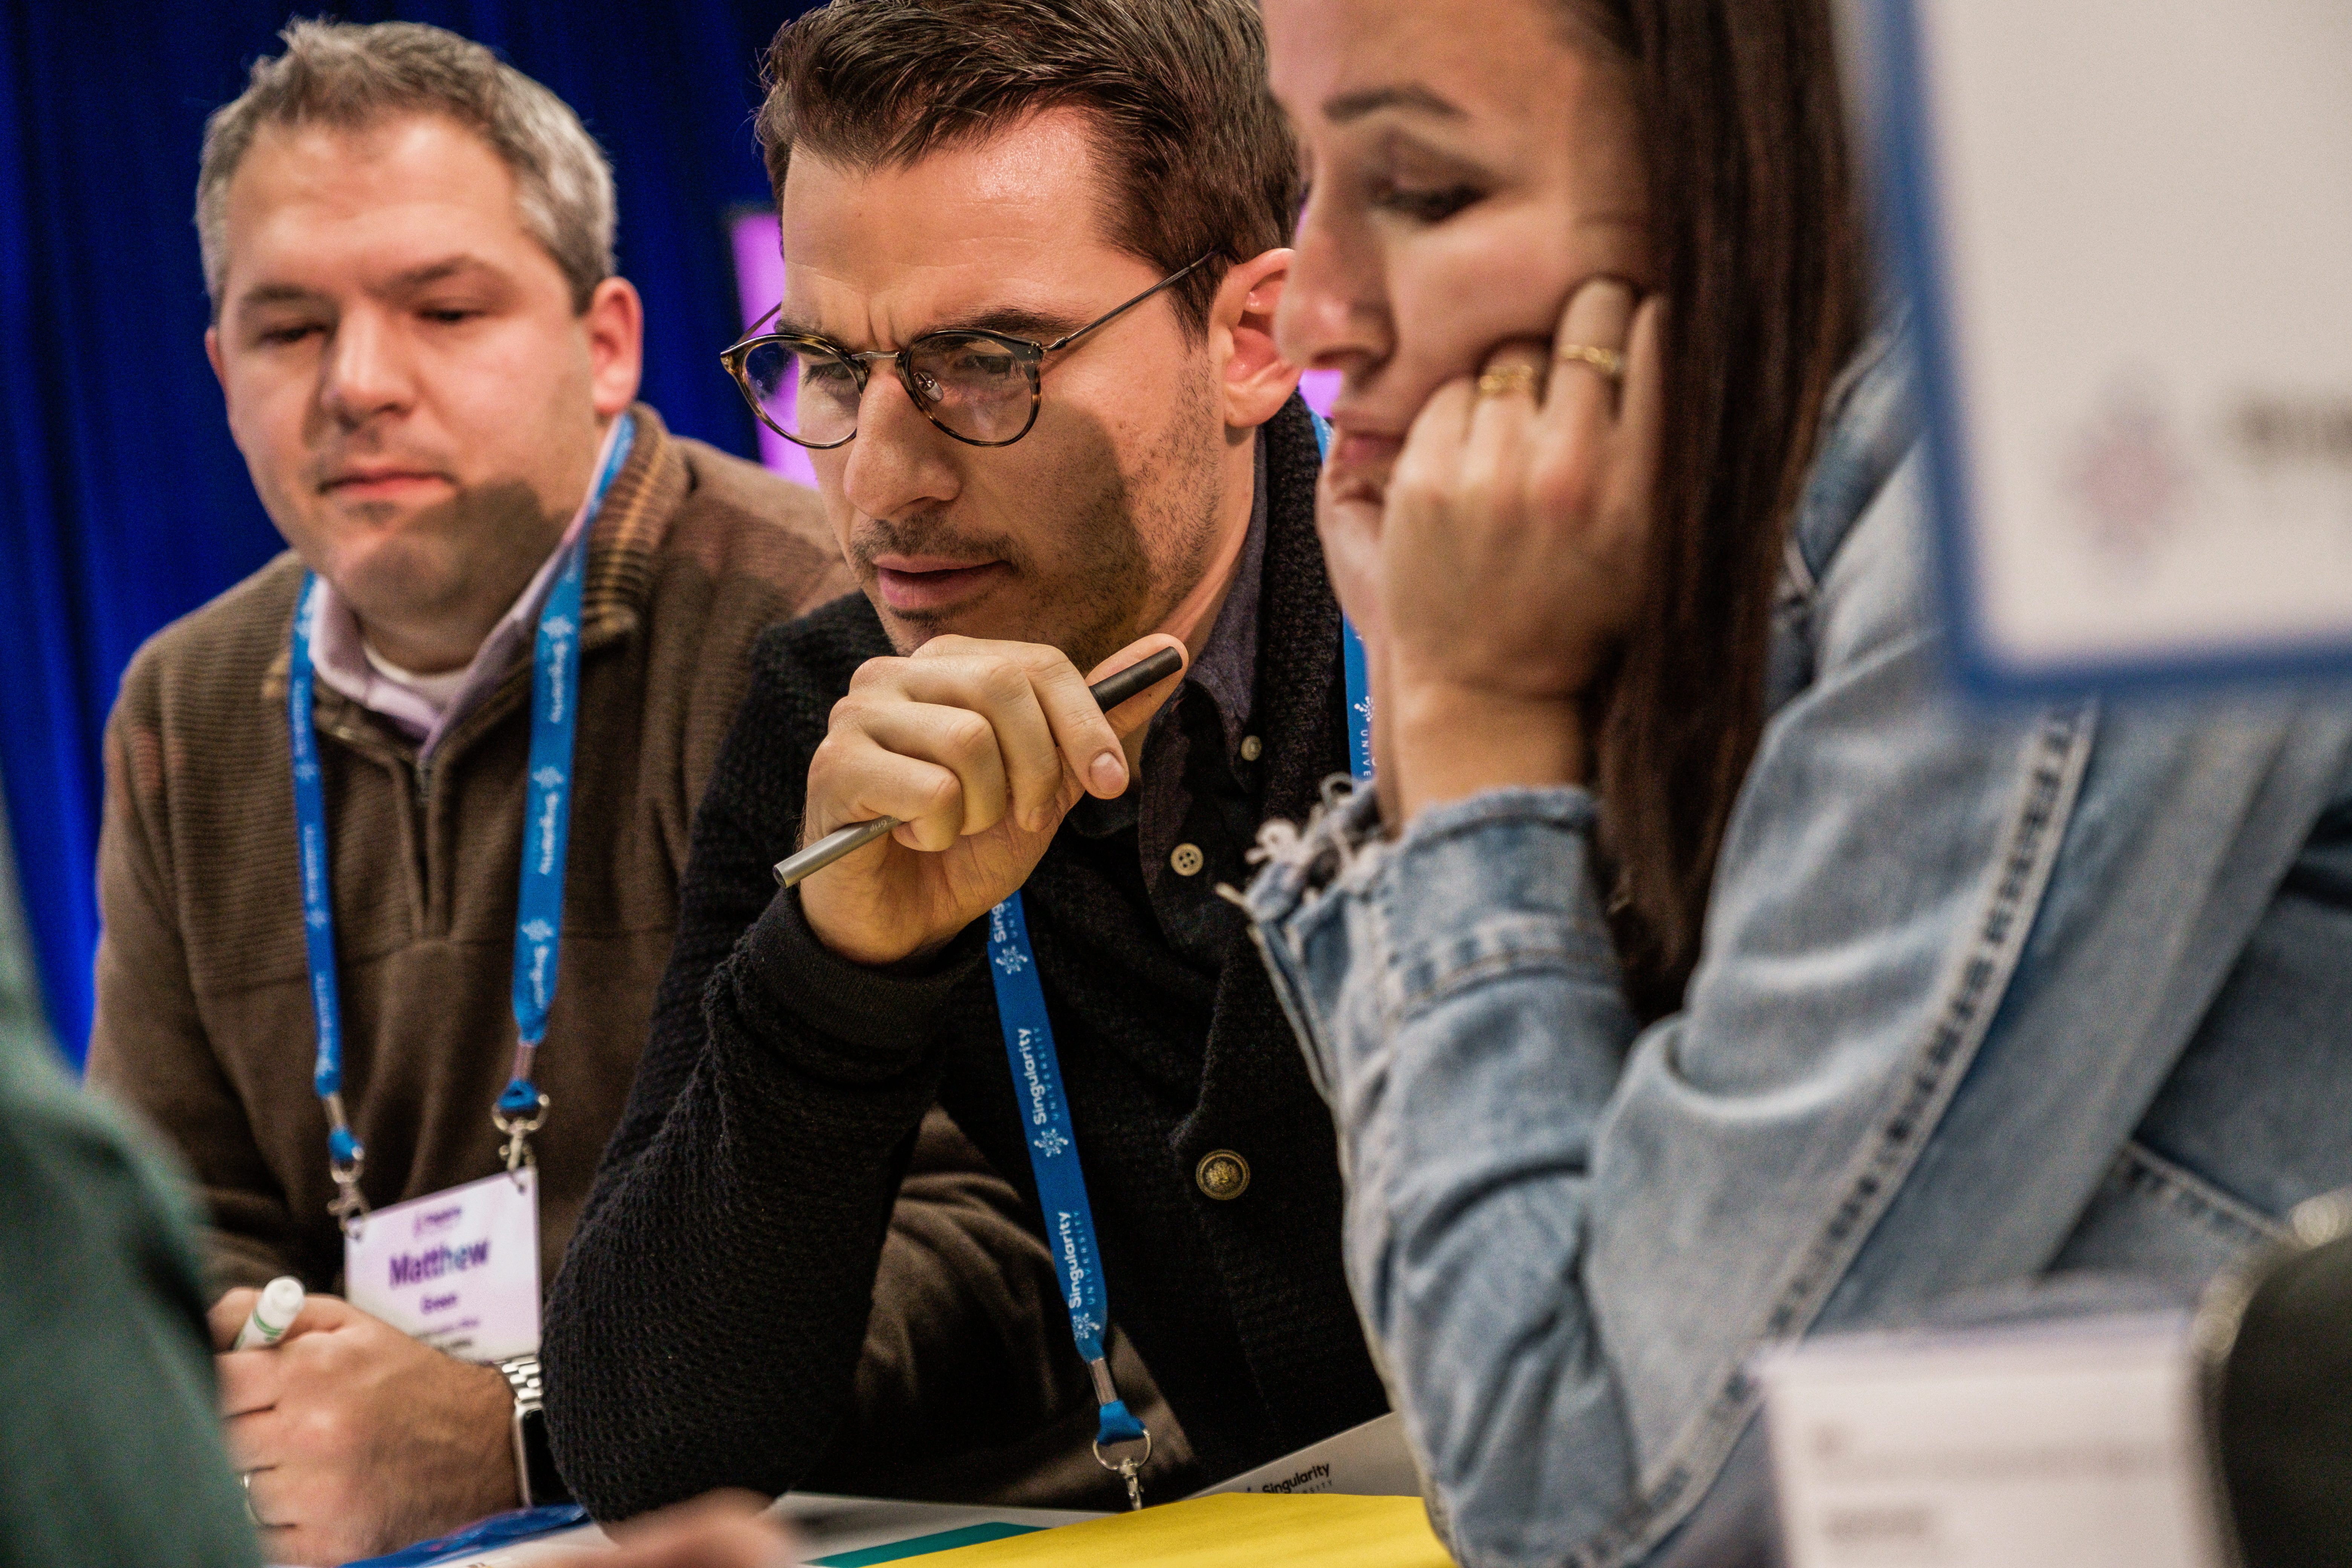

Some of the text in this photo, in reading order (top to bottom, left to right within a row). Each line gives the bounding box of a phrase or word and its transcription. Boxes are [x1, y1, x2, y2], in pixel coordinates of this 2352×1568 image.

[870, 820, 887, 831] Grip
[1018, 1028, 1047, 1125] Singularity
[1058, 1212, 1084, 1309] Singularity
